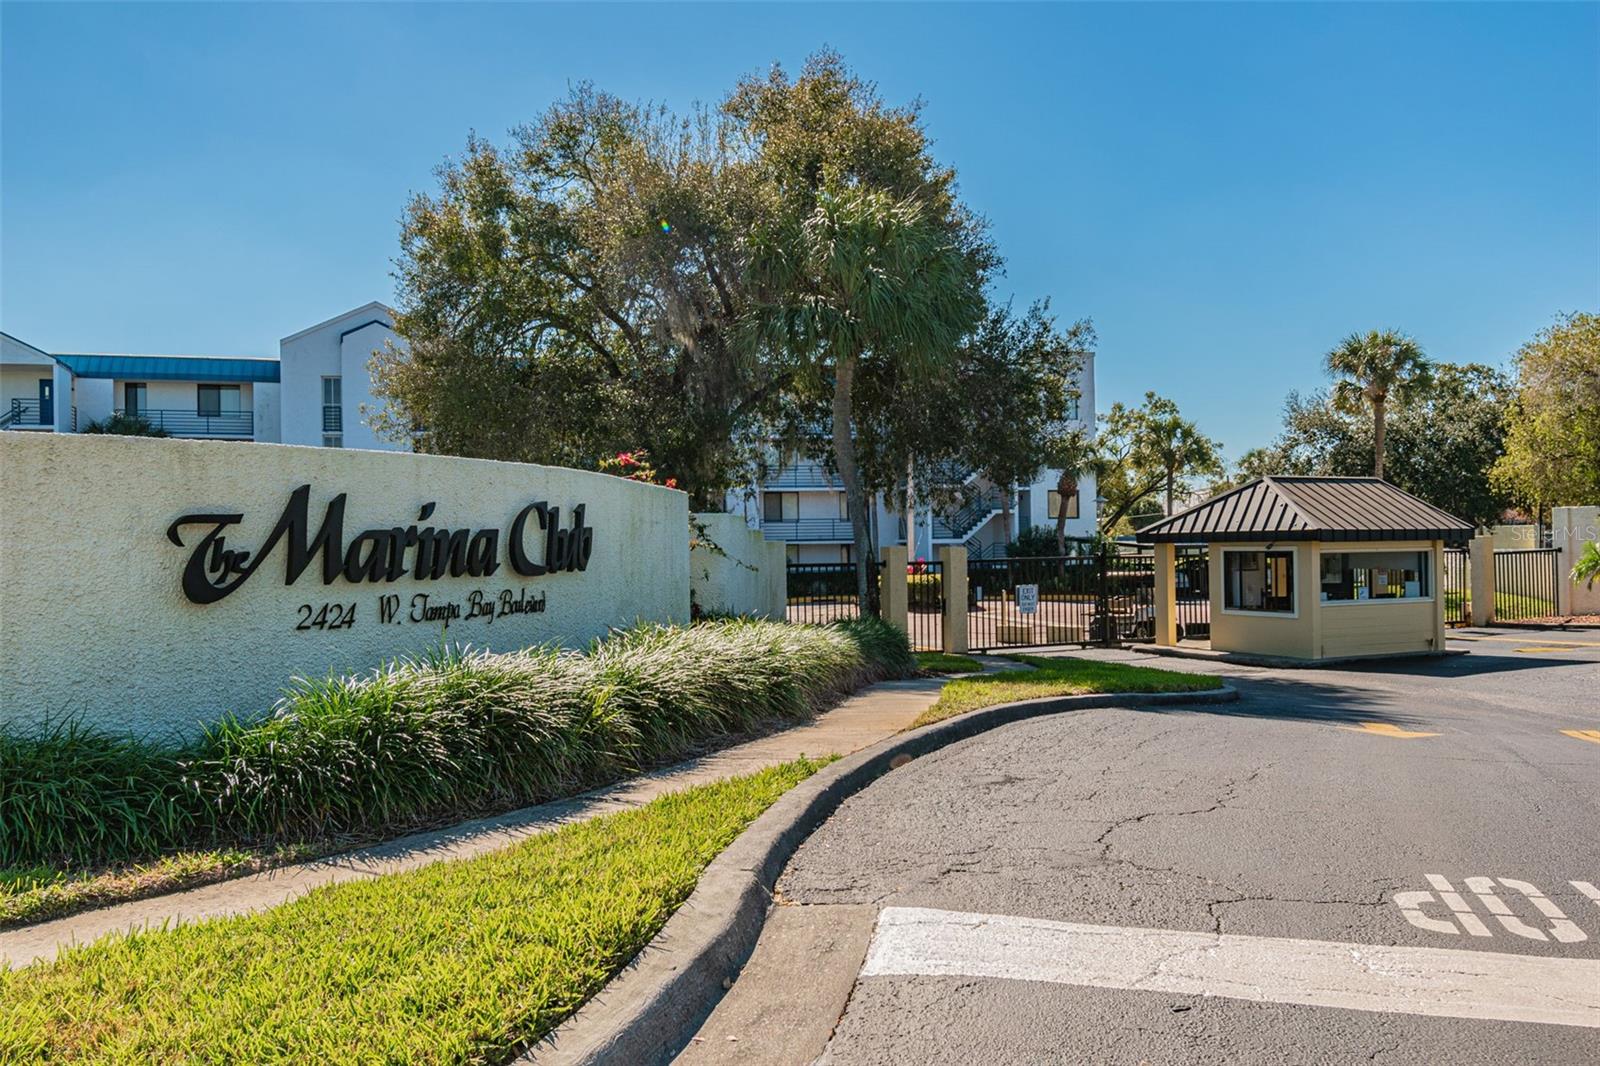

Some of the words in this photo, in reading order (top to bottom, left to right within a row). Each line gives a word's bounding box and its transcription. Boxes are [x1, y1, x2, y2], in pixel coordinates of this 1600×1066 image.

[167, 513, 250, 604] The
[244, 484, 500, 586] Marina
[509, 501, 593, 577] Club
[295, 602, 357, 631] 2424
[378, 594, 401, 625] W.
[410, 593, 461, 629] Tampa
[464, 590, 496, 625] Bay
